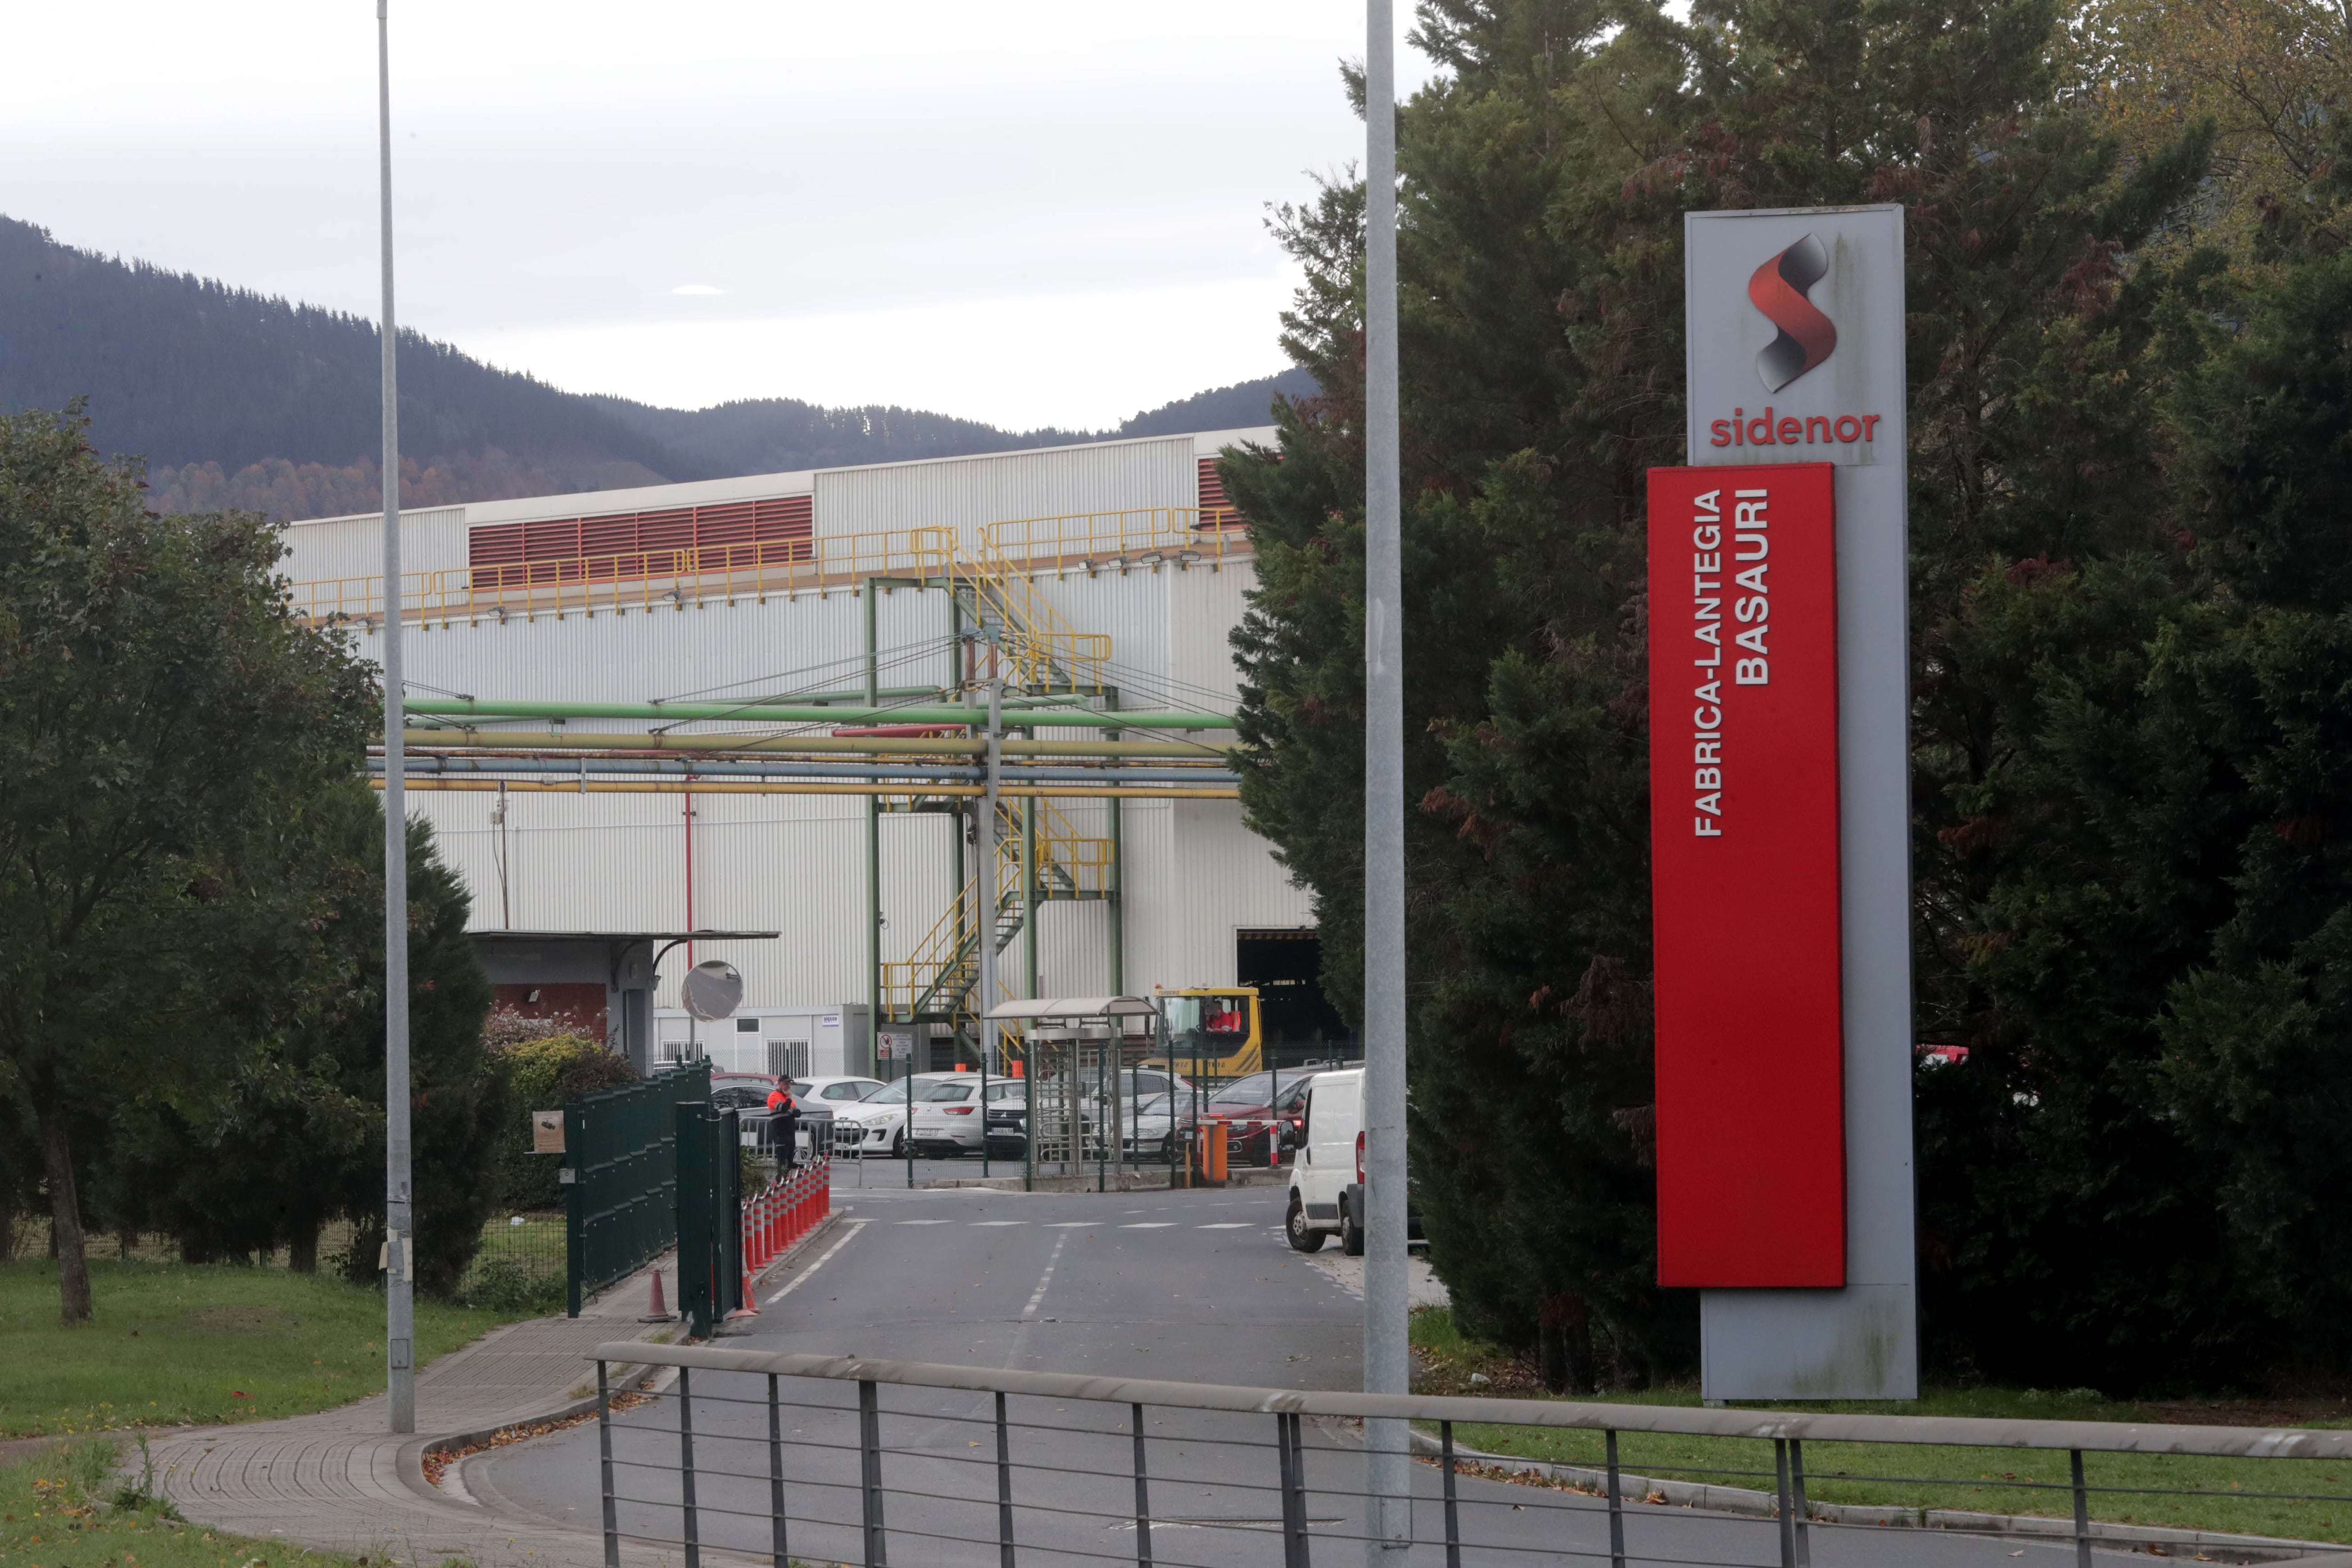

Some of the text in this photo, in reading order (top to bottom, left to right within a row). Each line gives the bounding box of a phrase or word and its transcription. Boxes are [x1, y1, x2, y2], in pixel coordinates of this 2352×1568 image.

[1710, 407, 1879, 446] sidenor
[1694, 489, 1722, 836] FABRICA-LANTEGIA
[1734, 489, 1769, 685] BASAURI
